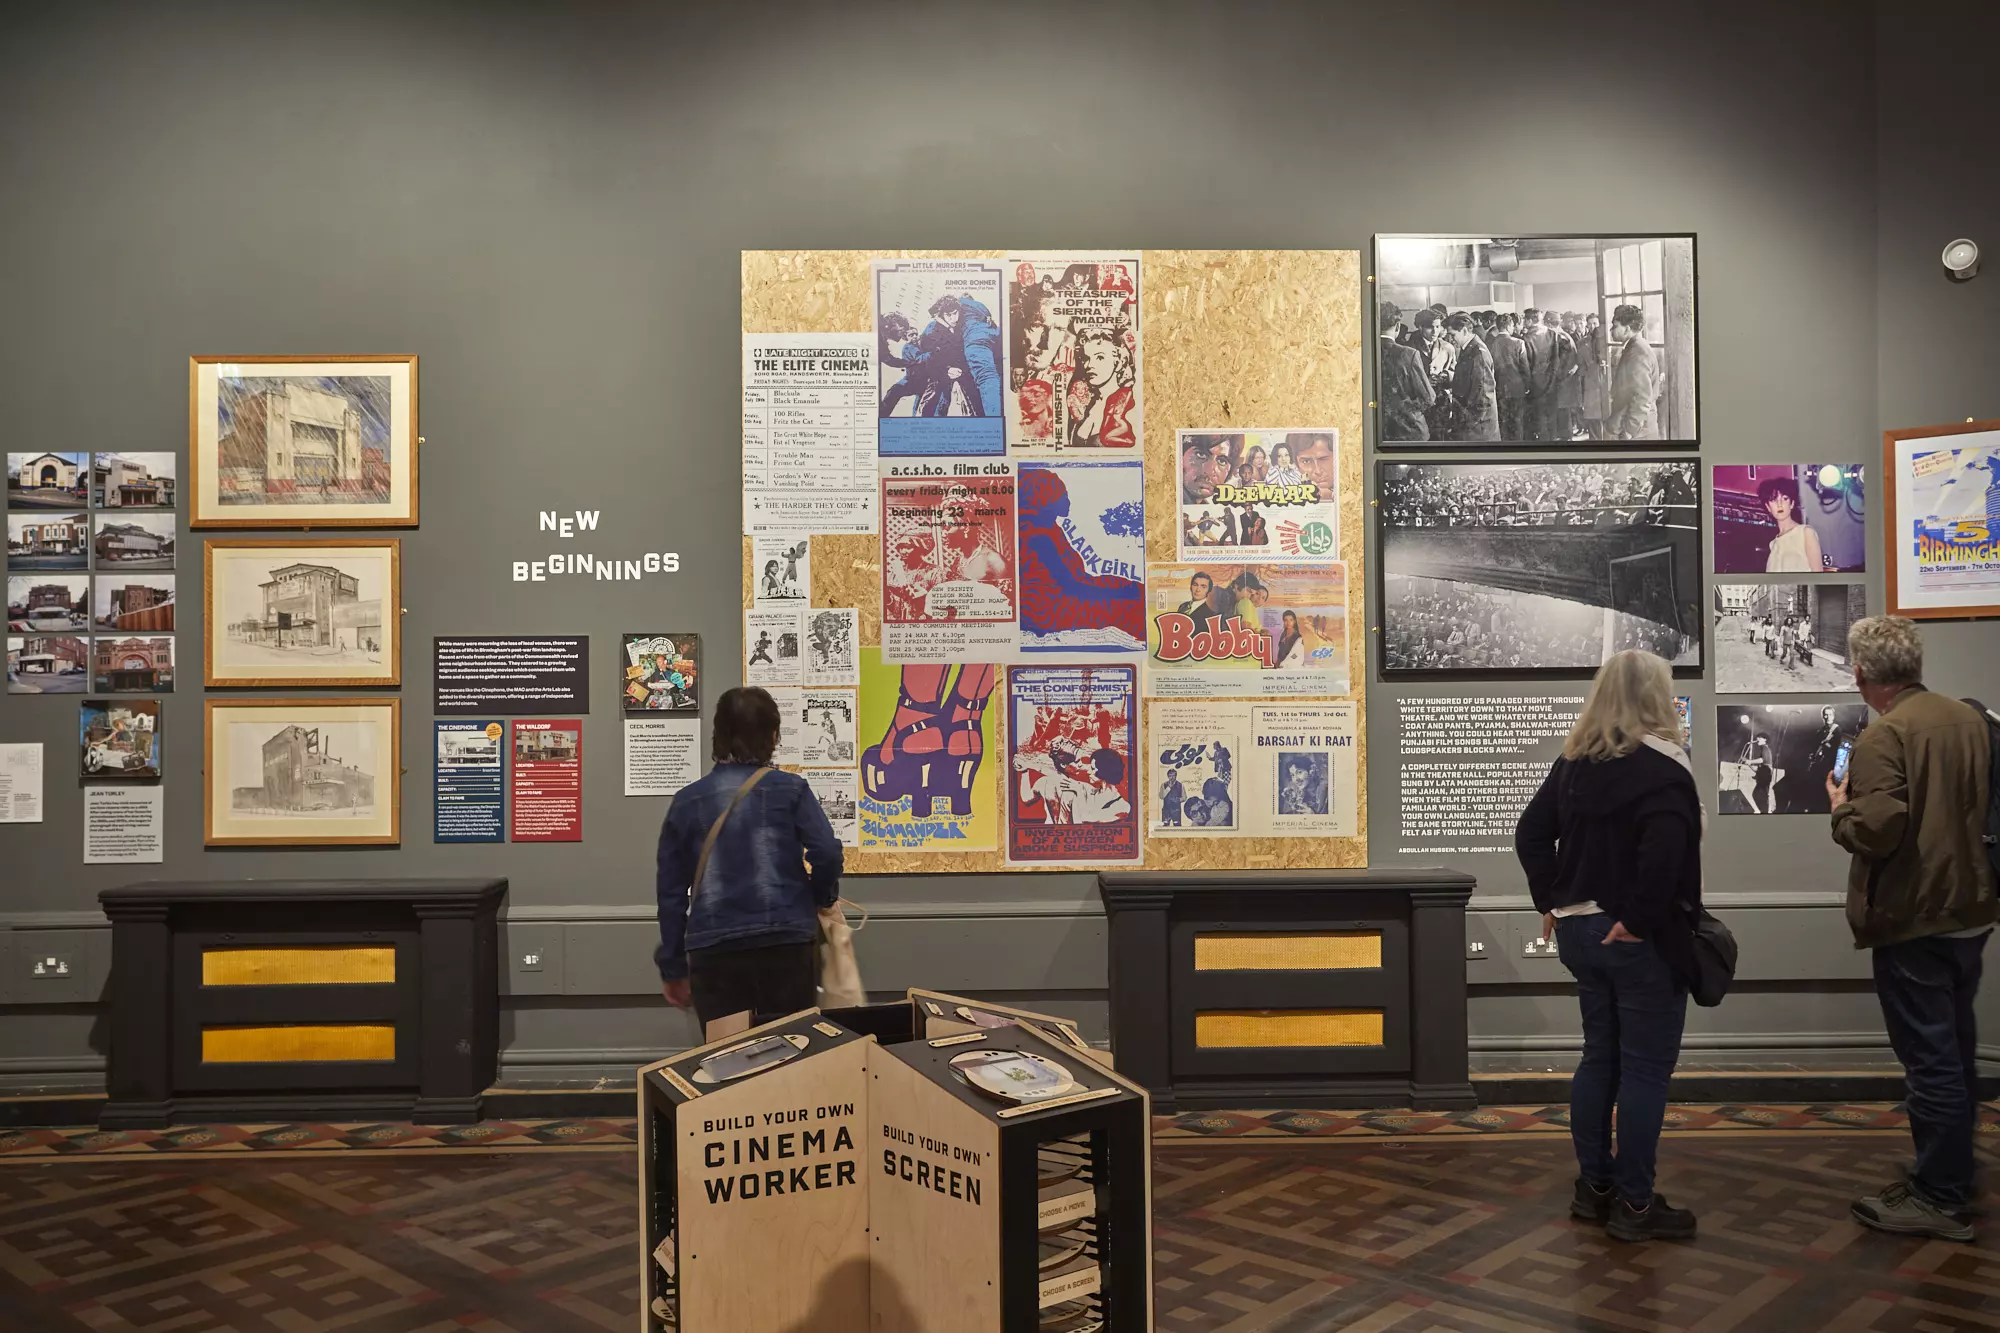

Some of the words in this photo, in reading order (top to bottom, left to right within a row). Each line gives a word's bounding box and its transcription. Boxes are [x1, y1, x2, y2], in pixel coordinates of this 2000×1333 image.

[1056, 290, 1127, 298] TREASURE
[1066, 299, 1084, 307] OF
[1087, 300, 1113, 308] THE
[764, 349, 789, 358] LATE
[791, 349, 820, 358] NIGHT
[822, 349, 857, 358] MOVIES
[754, 360, 778, 371] THE
[783, 360, 815, 371] ELITE
[821, 360, 868, 371] CINEMA
[1054, 373, 1062, 424] MISFITS
[891, 464, 947, 476] a.c.s.h.o.
[954, 464, 978, 475] film
[983, 463, 1010, 475] club
[887, 489, 916, 498] every
[919, 486, 950, 496] friday
[952, 486, 978, 497] night
[992, 486, 1014, 495] 8.00
[1216, 482, 1318, 504] DEEWAAR
[892, 507, 945, 519] beginning
[947, 507, 965, 517] 23
[974, 508, 1006, 516] march
[540, 510, 600, 538] NEW
[1062, 518, 1101, 574] BLACK
[513, 552, 680, 581] BEGINNINGS
[1156, 612, 1274, 668] Bobby
[1016, 685, 1042, 693] THE
[1258, 736, 1304, 746] BARSAAT
[1310, 736, 1320, 746] KI
[1325, 736, 1352, 746] RAAT
[1024, 829, 1122, 838] INVESTIGATION
[1013, 844, 1058, 853] ABOVE
[1064, 844, 1135, 852] SUSPICION
[704, 1115, 754, 1133] BUILD
[763, 1109, 808, 1125] YOUR
[816, 1103, 854, 1119] OWN
[705, 1126, 854, 1168] CINEMA
[883, 1124, 914, 1145] BUILD
[919, 1136, 949, 1156] YOUR
[953, 1146, 981, 1167] OWN
[704, 1161, 856, 1204] WORKER
[883, 1149, 981, 1206] SCREEN
[1039, 1207, 1063, 1219] CHOOSE
[1068, 1201, 1086, 1211] MOVIE
[1043, 1285, 1066, 1297] CHOOSE
[1072, 1276, 1095, 1289] SCREEN
